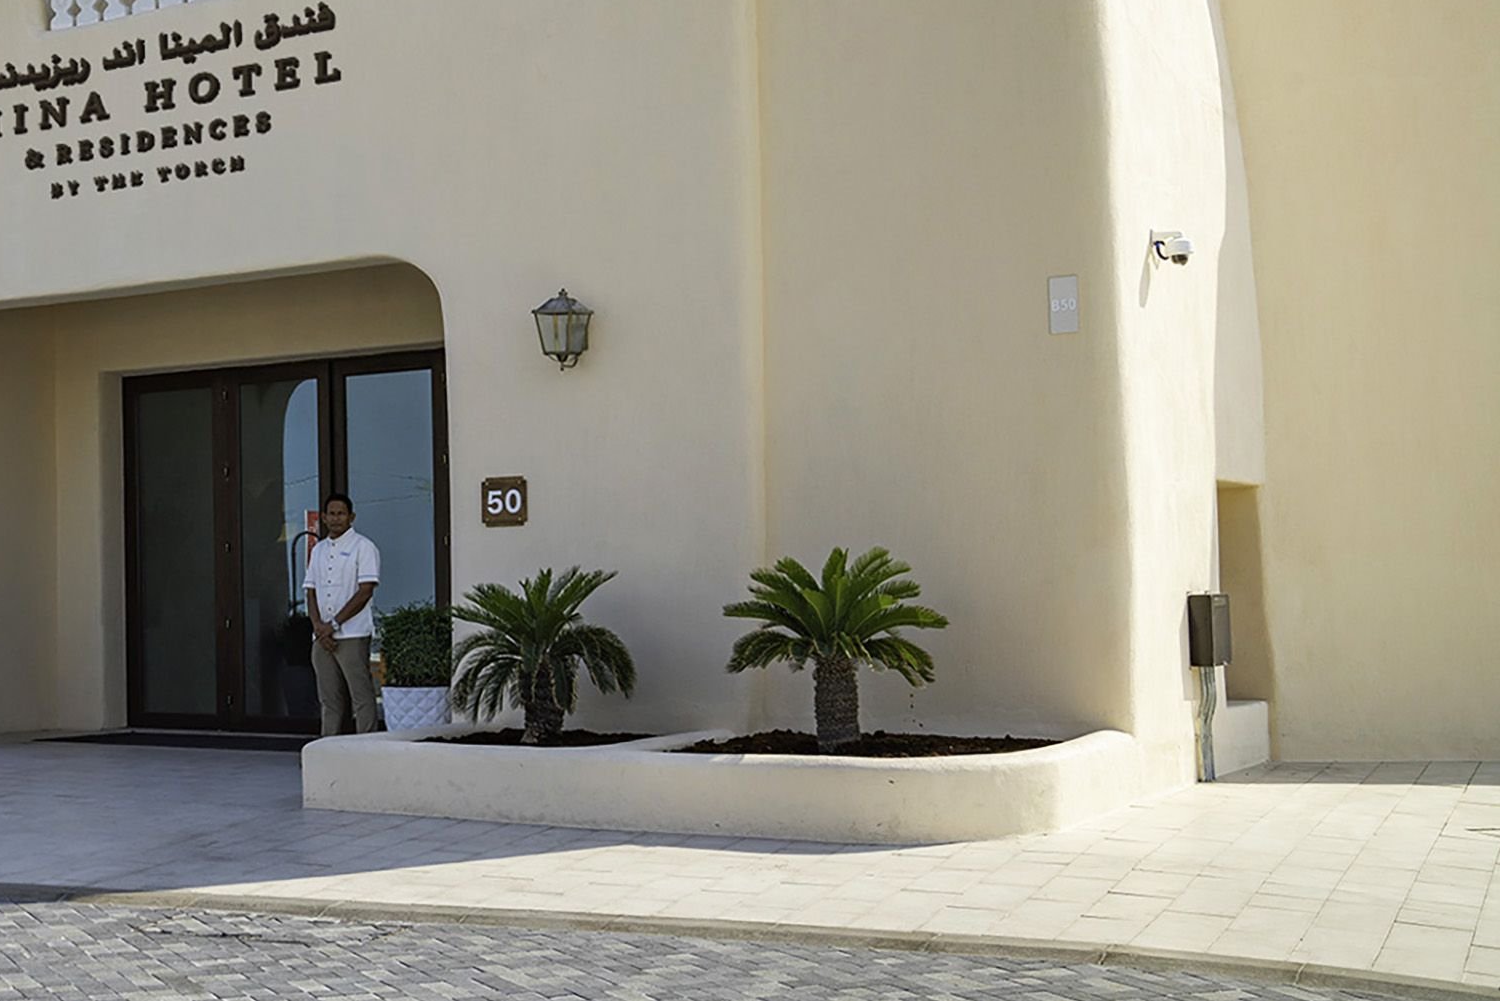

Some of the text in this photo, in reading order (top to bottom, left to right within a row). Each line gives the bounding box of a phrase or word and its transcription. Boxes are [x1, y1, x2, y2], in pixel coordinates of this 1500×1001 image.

[158, 19, 243, 65] المينا
[253, 1, 336, 51] فندق
[102, 38, 146, 72] اند
[143, 50, 342, 114] HOTEL
[24, 111, 272, 171] & RESIDENCES
[50, 155, 246, 200] BY THE TORCH
[1051, 298, 1077, 311] B50
[487, 488, 522, 514] 50
